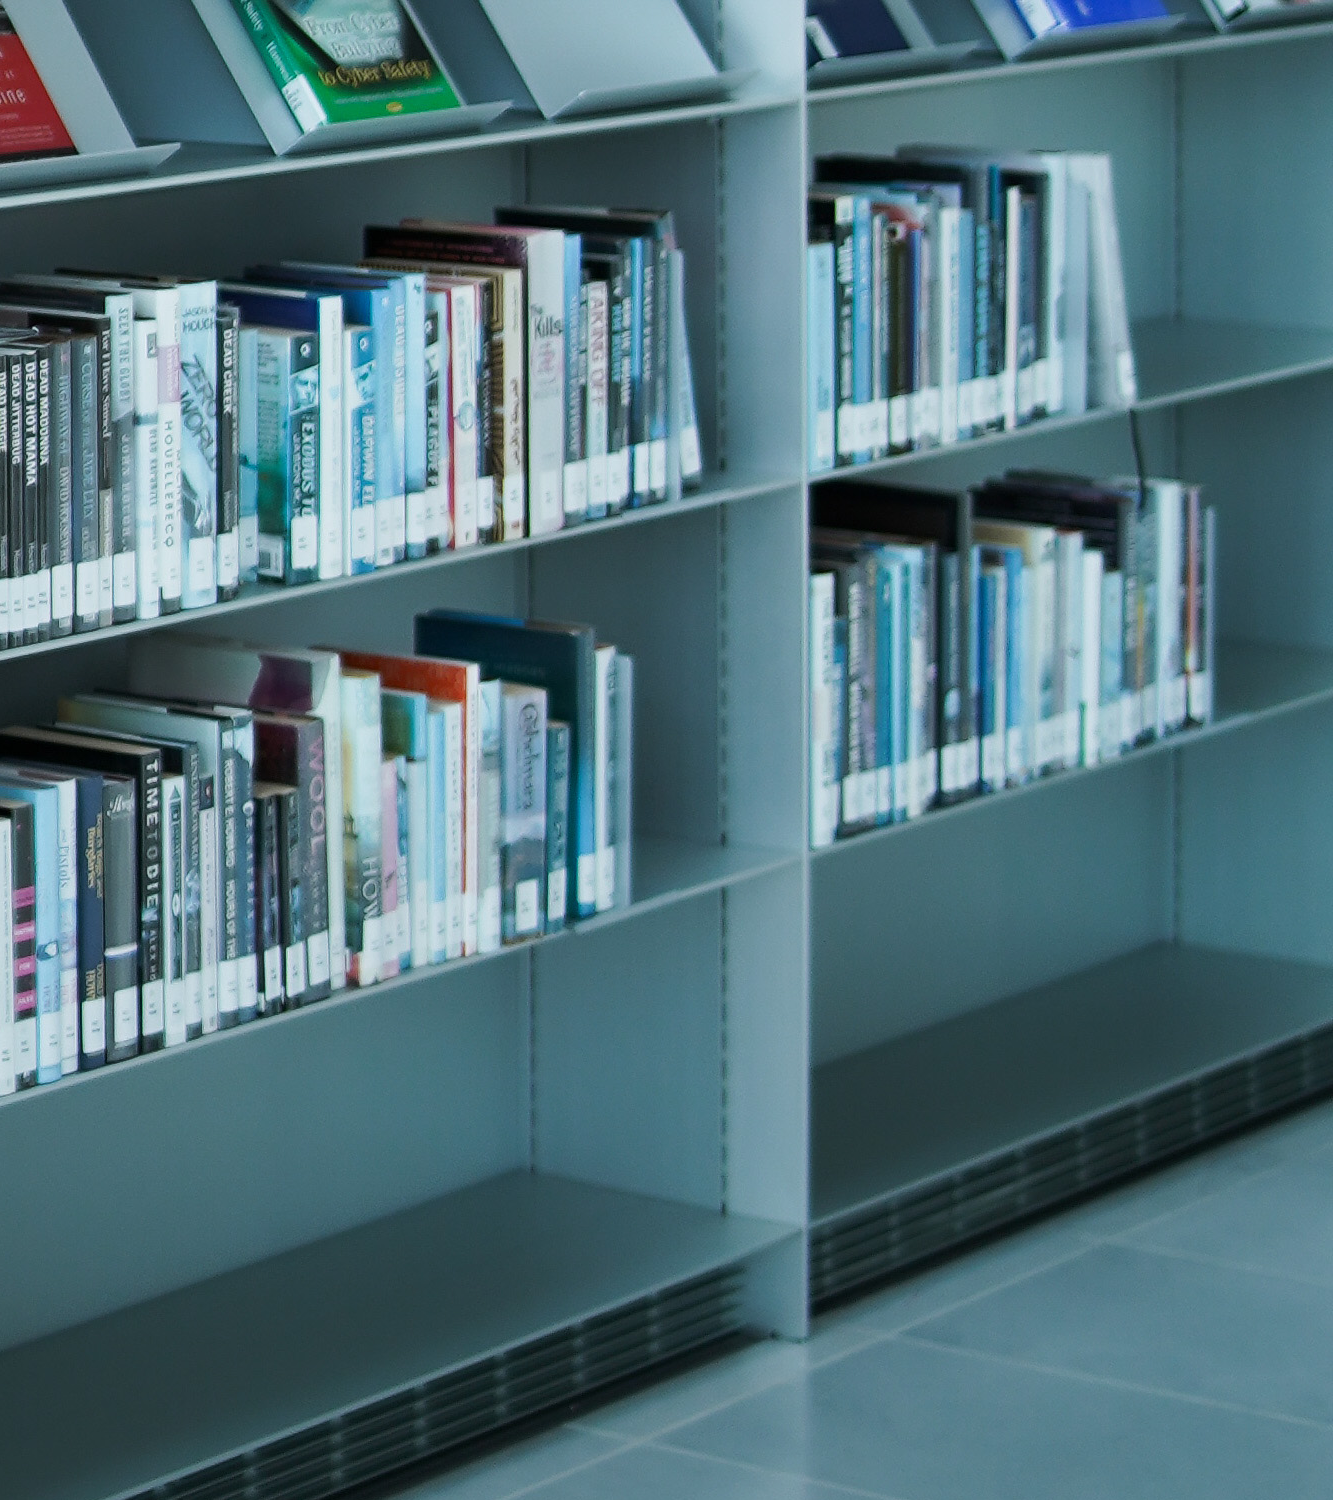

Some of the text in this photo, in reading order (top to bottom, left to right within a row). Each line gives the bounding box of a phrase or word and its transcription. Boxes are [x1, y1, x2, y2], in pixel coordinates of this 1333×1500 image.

[11, 364, 21, 397] DEAD
[24, 363, 36, 486] DEAD HOT MAMA
[40, 359, 49, 393] DEAD
[164, 420, 174, 547] HOUELLEBECQ
[301, 422, 314, 493] EXODUS
[146, 759, 159, 907] TIME DIE
[310, 736, 323, 855] WOOL
